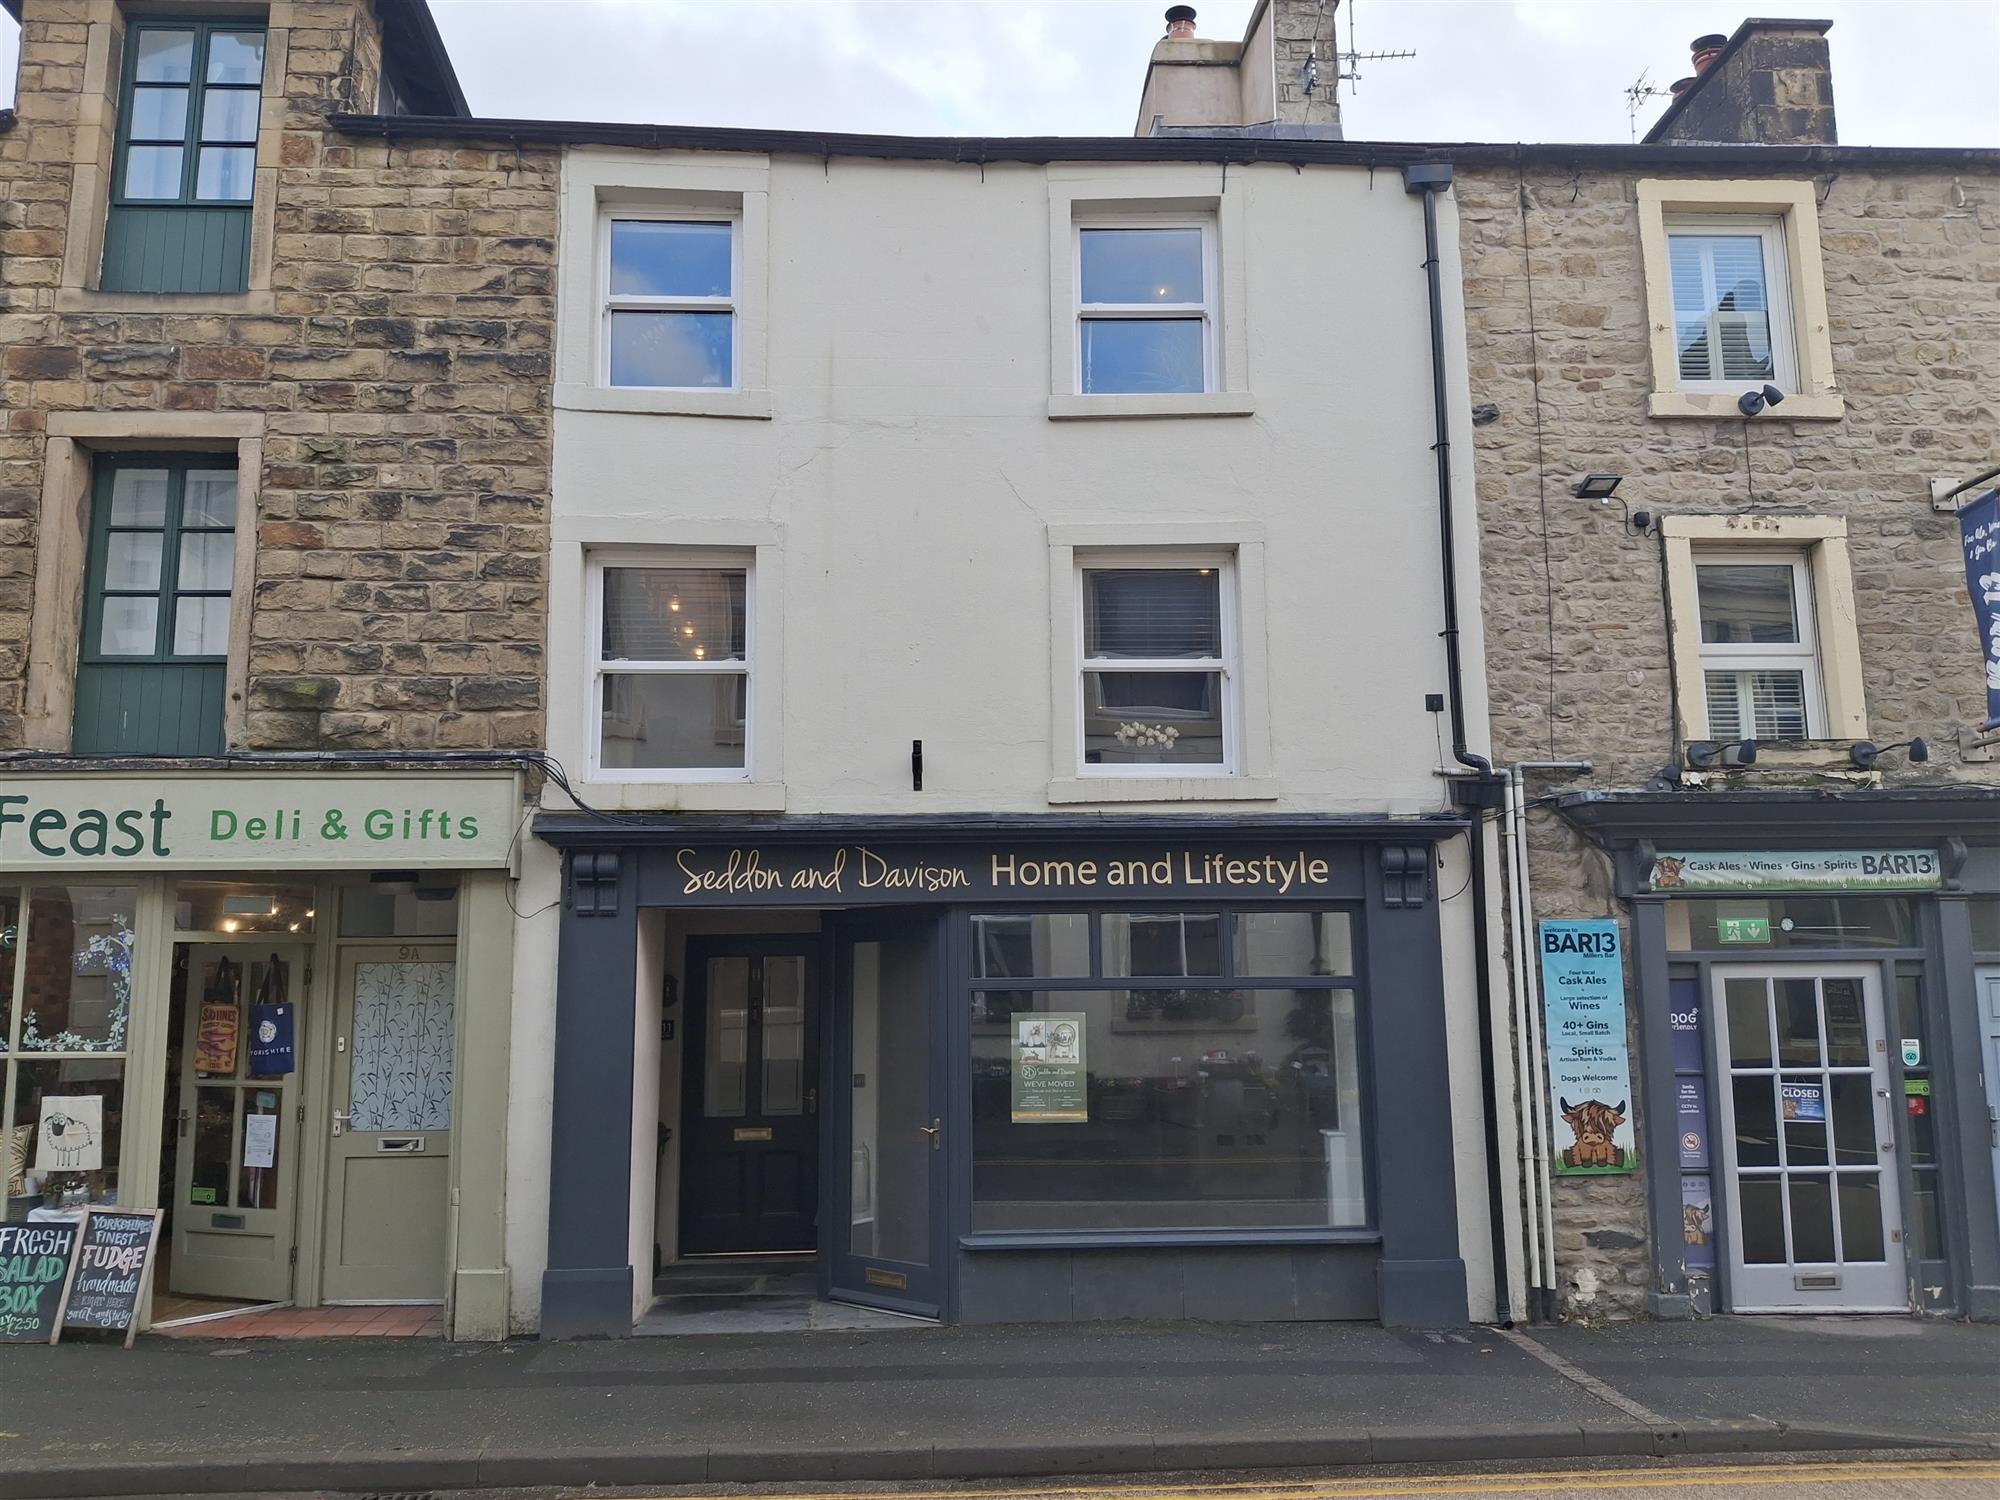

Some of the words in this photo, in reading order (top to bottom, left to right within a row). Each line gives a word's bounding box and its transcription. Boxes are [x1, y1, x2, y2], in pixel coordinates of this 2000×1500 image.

[0, 795, 171, 856] Feast
[210, 809, 301, 841] Deli
[320, 808, 348, 841] &
[364, 808, 479, 841] Gifts
[676, 848, 784, 895] Seddon
[790, 848, 846, 894] and
[855, 846, 971, 892] Davison
[991, 853, 1098, 886] Home
[1106, 851, 1173, 886] and
[1184, 850, 1329, 894] Lifestyle
[1688, 860, 1716, 871] Cask
[1717, 861, 1741, 871] Ales
[1749, 861, 1783, 871] Wines
[1790, 860, 1816, 871] Gins
[1823, 859, 1858, 872] Spirits
[1861, 853, 1932, 875] BAR13
[1544, 932, 1616, 953] BAR13
[399, 944, 420, 960] 9A
[1558, 976, 1583, 986] Cask
[1585, 976, 1607, 986] Ales
[1569, 1001, 1601, 1010] Wines
[1670, 1013, 1697, 1024] DOG
[1562, 1021, 1584, 1030] 40+
[1586, 1021, 1609, 1030] Gins
[1571, 1046, 1604, 1058] Spirits
[1048, 1080, 1075, 1088] MOVED
[1560, 1074, 1581, 1083] Dogs
[1582, 1073, 1618, 1081] Welcome
[1782, 1089, 1820, 1098] CLOSED
[95, 1231, 138, 1246] FINEST
[82, 1245, 146, 1276] FUDGE
[77, 1271, 137, 1294] handmade
